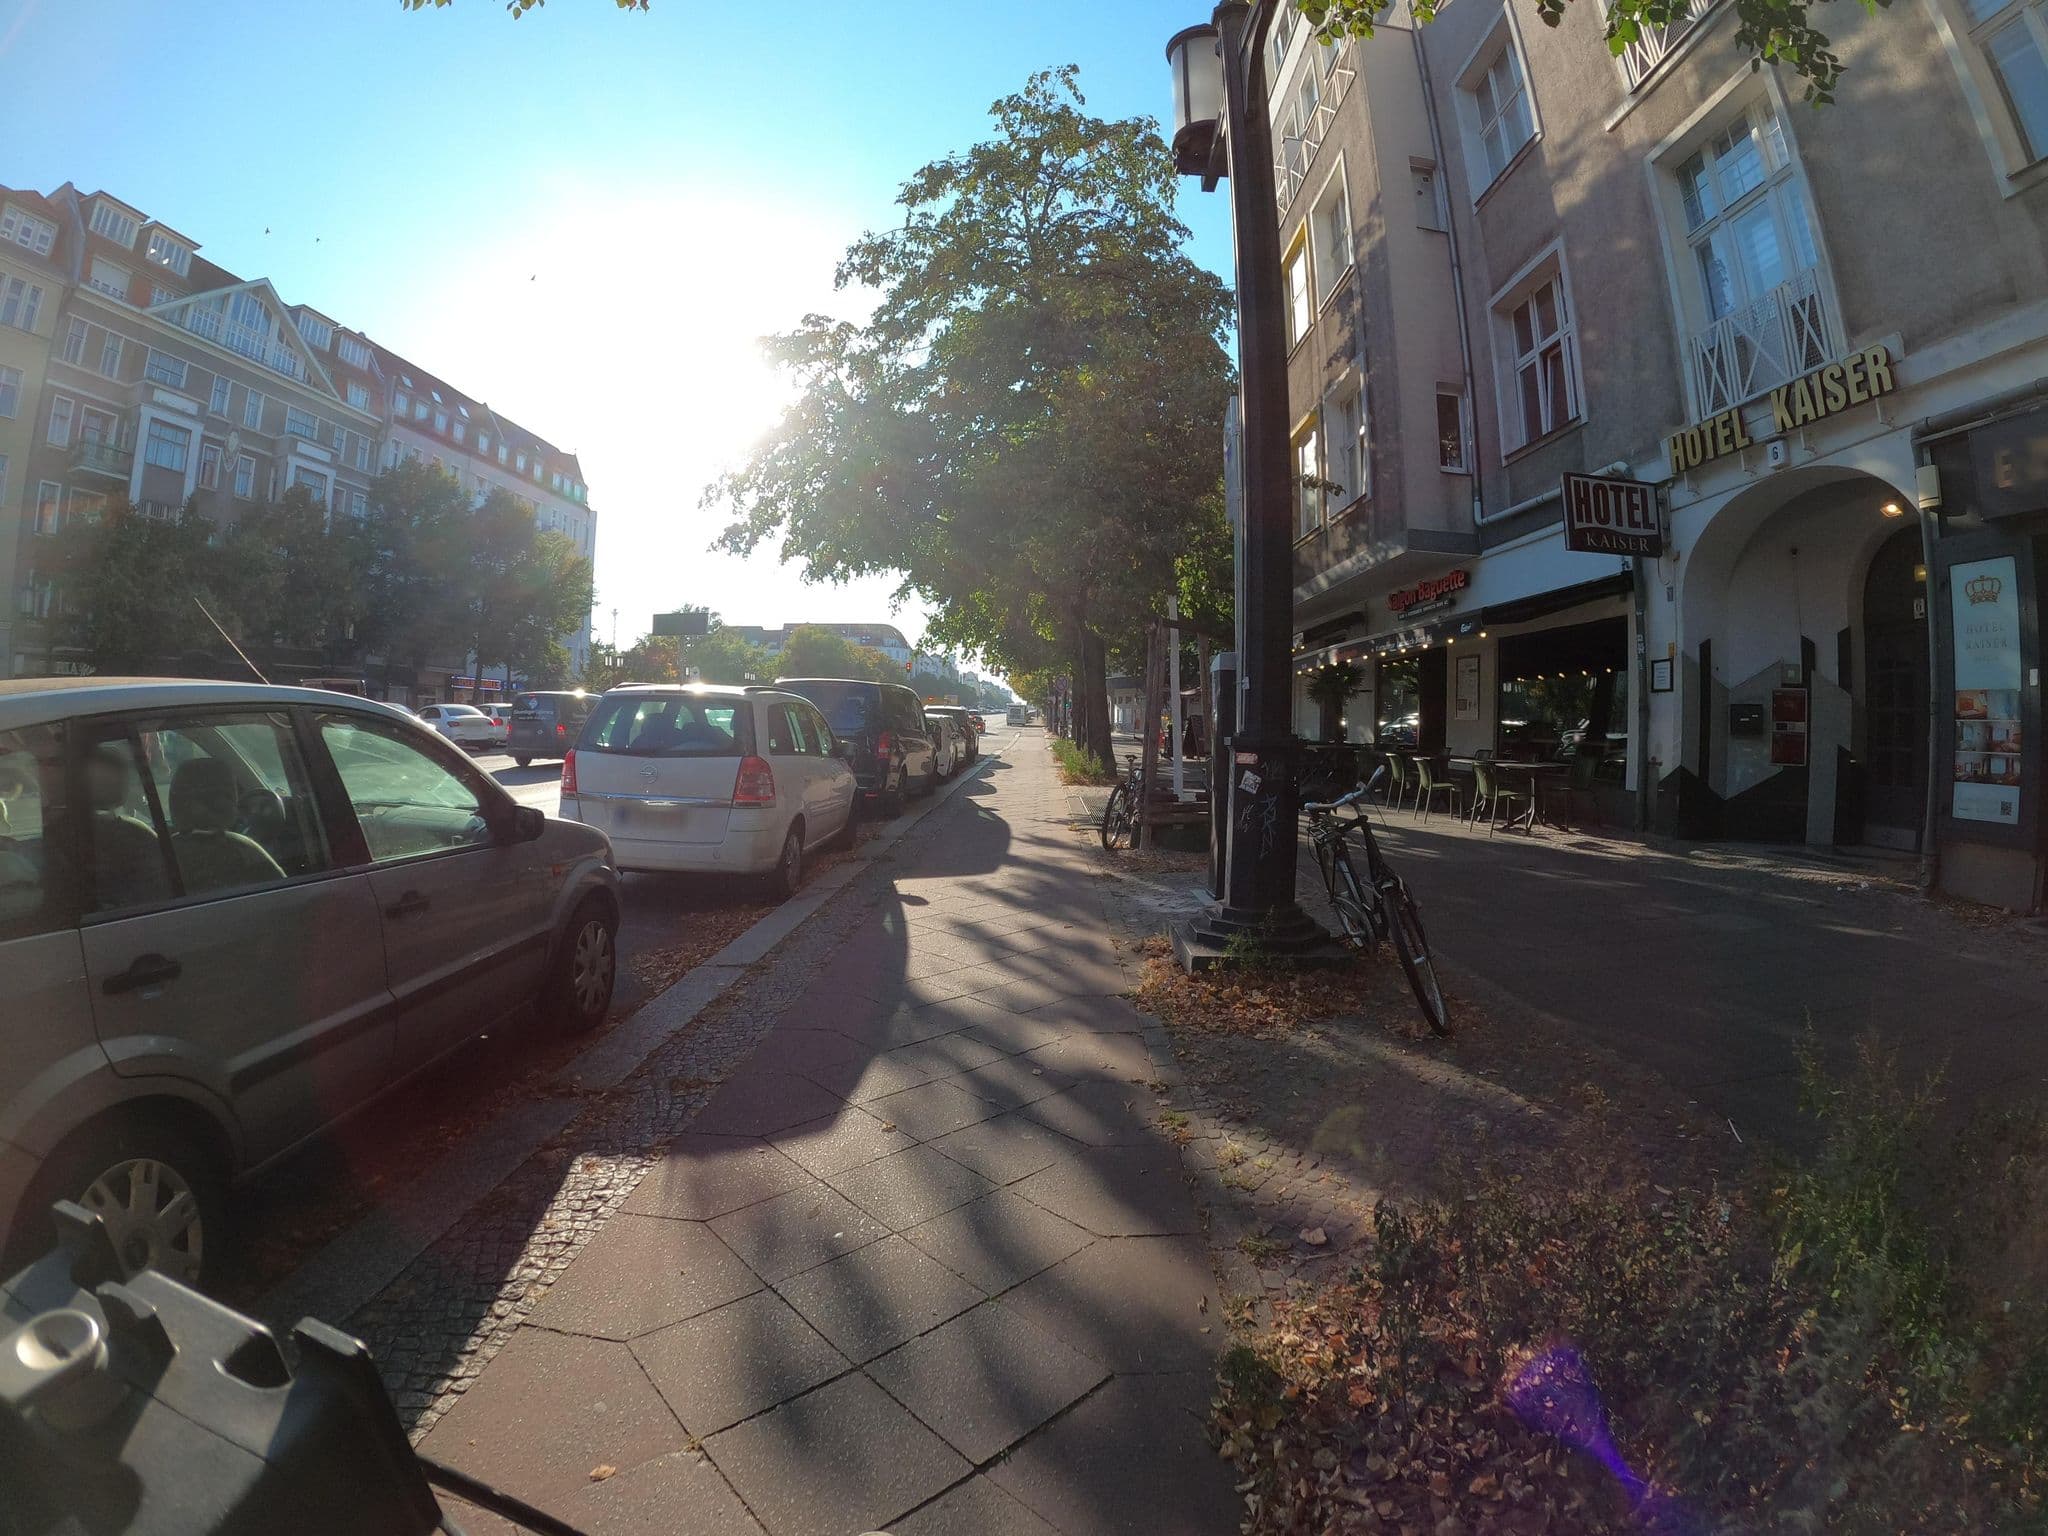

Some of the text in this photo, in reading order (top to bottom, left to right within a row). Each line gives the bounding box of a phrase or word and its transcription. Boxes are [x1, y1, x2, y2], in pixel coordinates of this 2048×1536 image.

[1669, 344, 1895, 474] HOTEL KAISER
[1771, 446, 1780, 460] 6
[1573, 480, 1656, 532] HOTEL
[1585, 531, 1651, 553] KAISER
[1418, 570, 1465, 599] Baguette
